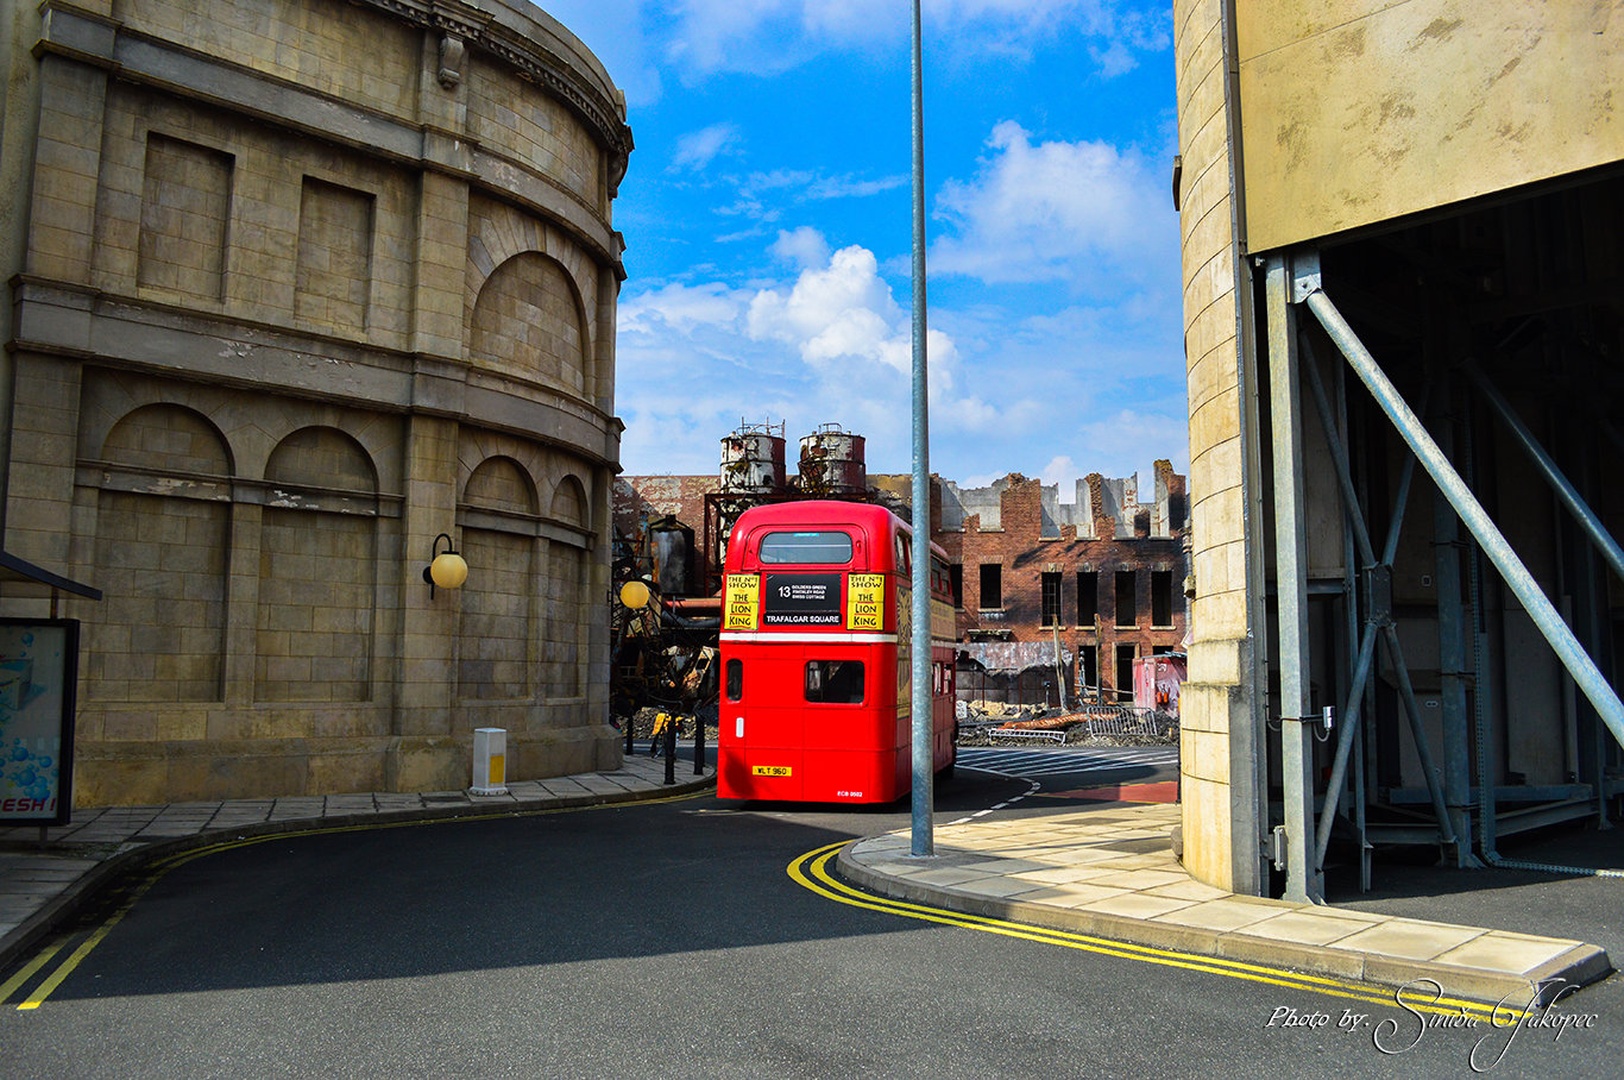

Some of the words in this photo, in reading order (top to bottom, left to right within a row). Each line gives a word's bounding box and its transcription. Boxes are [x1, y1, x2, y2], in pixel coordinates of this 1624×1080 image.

[778, 586, 791, 598] 13
[734, 594, 748, 602] THE
[858, 594, 873, 602] THE
[731, 604, 751, 613] LION
[856, 604, 877, 613] LION
[730, 616, 751, 625] KING
[767, 615, 809, 623] TRAFALGAR
[854, 616, 877, 625] KING
